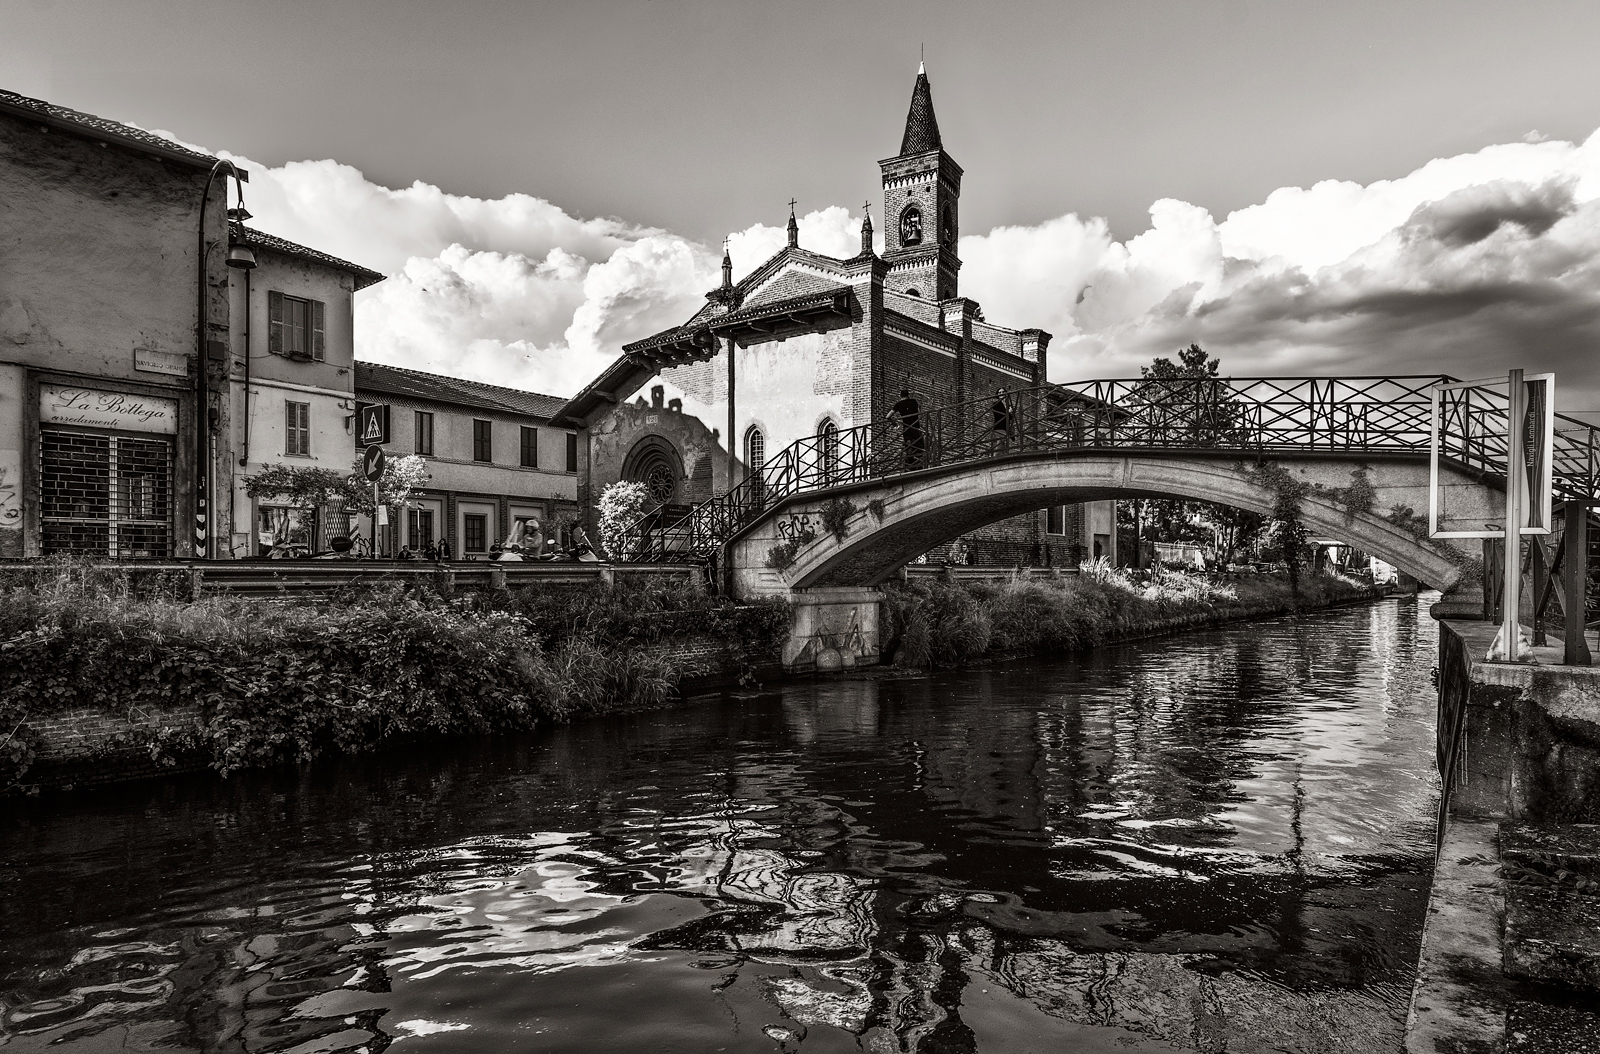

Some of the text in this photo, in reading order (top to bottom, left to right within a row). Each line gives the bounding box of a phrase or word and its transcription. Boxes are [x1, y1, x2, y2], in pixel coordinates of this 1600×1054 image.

[52, 389, 165, 422] La Bottega
[51, 415, 119, 426] arredamenti
[1527, 412, 1535, 442] Lombardi
[1527, 445, 1536, 467] Navigli
